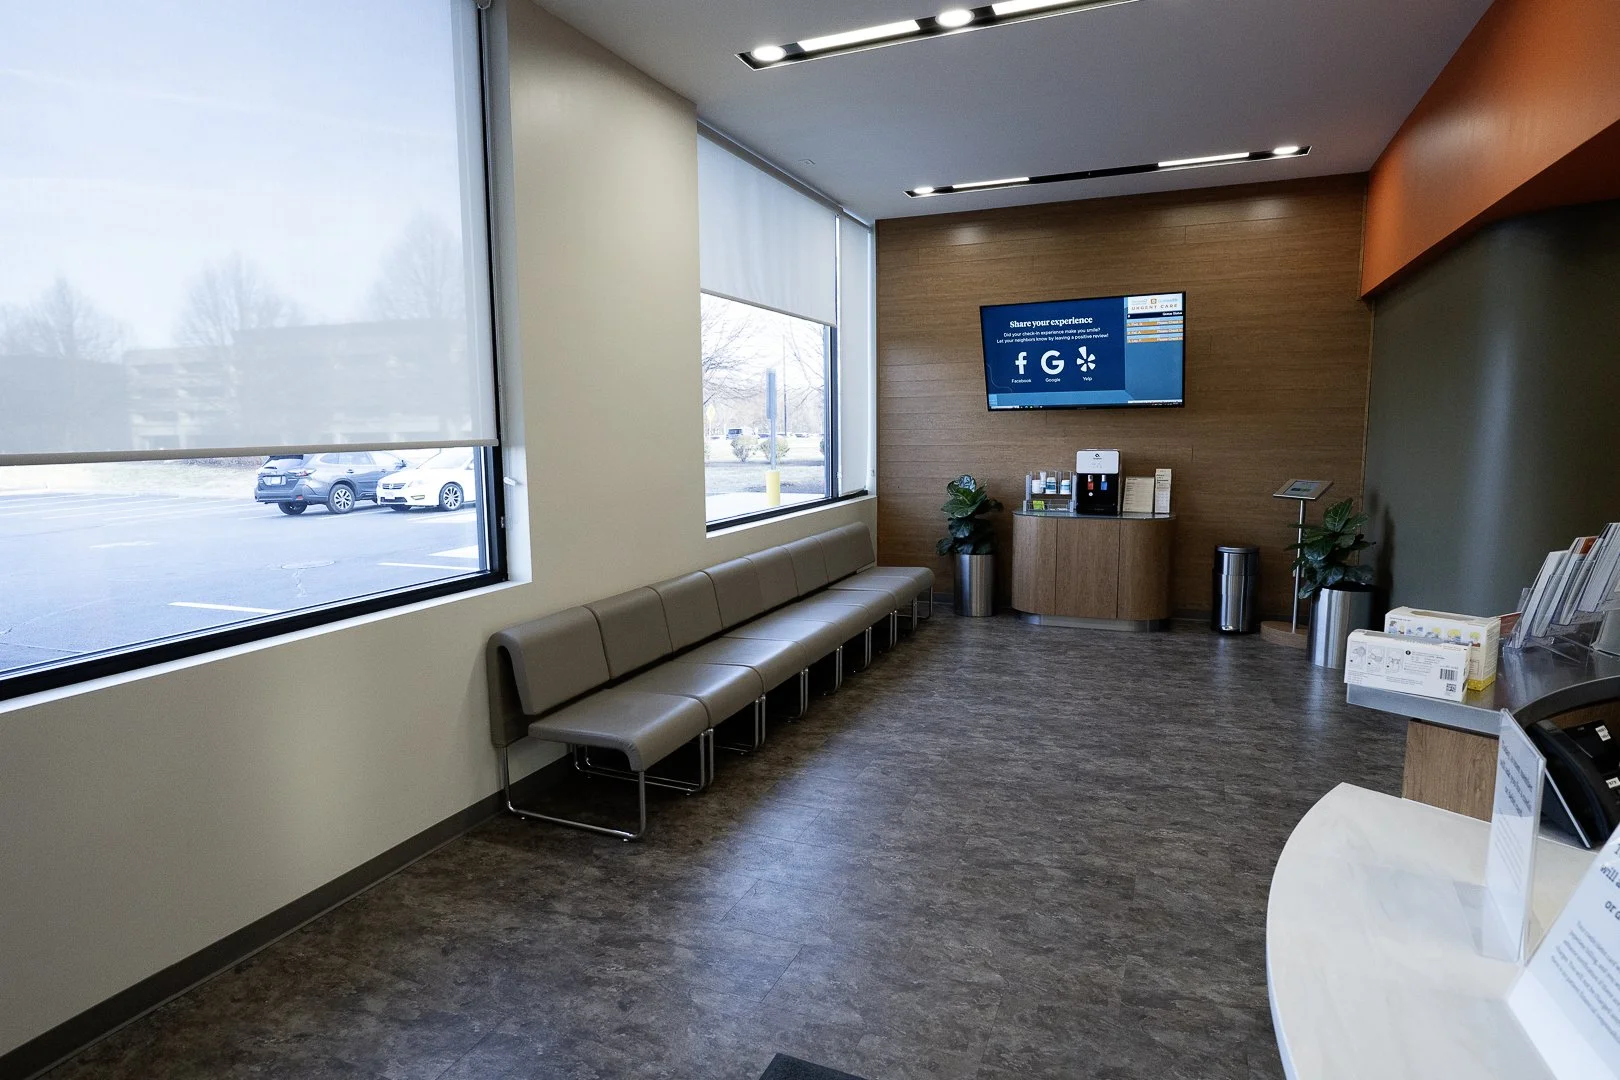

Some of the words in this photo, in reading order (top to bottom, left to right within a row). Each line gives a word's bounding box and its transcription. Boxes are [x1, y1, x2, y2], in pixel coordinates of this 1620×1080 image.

[1009, 320, 1032, 329] Share
[1032, 320, 1050, 329] your
[1050, 316, 1093, 327] experience
[1040, 328, 1065, 336] experience
[1600, 866, 1619, 882] will
[1605, 900, 1617, 913] or
